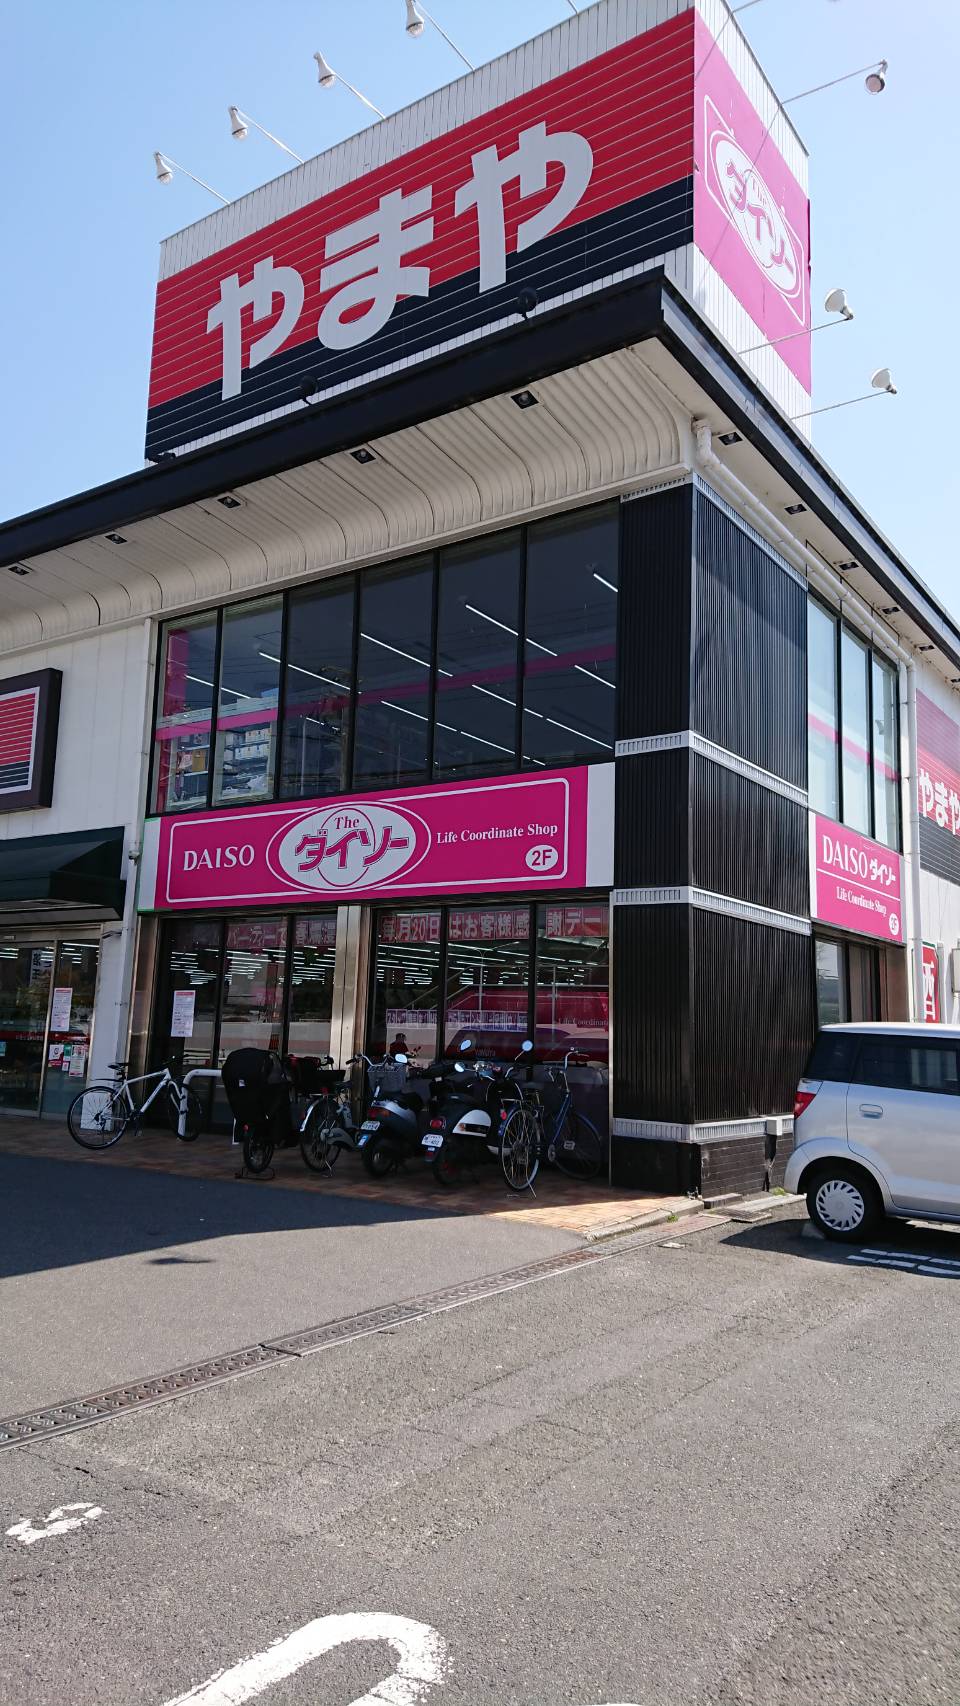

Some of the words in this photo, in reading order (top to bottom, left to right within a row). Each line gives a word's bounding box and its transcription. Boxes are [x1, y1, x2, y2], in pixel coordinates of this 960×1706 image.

[207, 121, 594, 400] やまや
[919, 768, 960, 835] やまや
[334, 816, 360, 830] The
[437, 832, 458, 844] Life
[460, 827, 524, 842] Coordinate
[527, 823, 558, 837] Shop
[184, 844, 255, 871] DAISO
[294, 826, 409, 872] ダイソー
[531, 849, 553, 867] 2F
[823, 835, 868, 878] DAISO
[869, 858, 896, 886] ダイソー
[836, 886, 848, 902] Life
[848, 890, 875, 911] Coordinate
[875, 899, 887, 917] Shop
